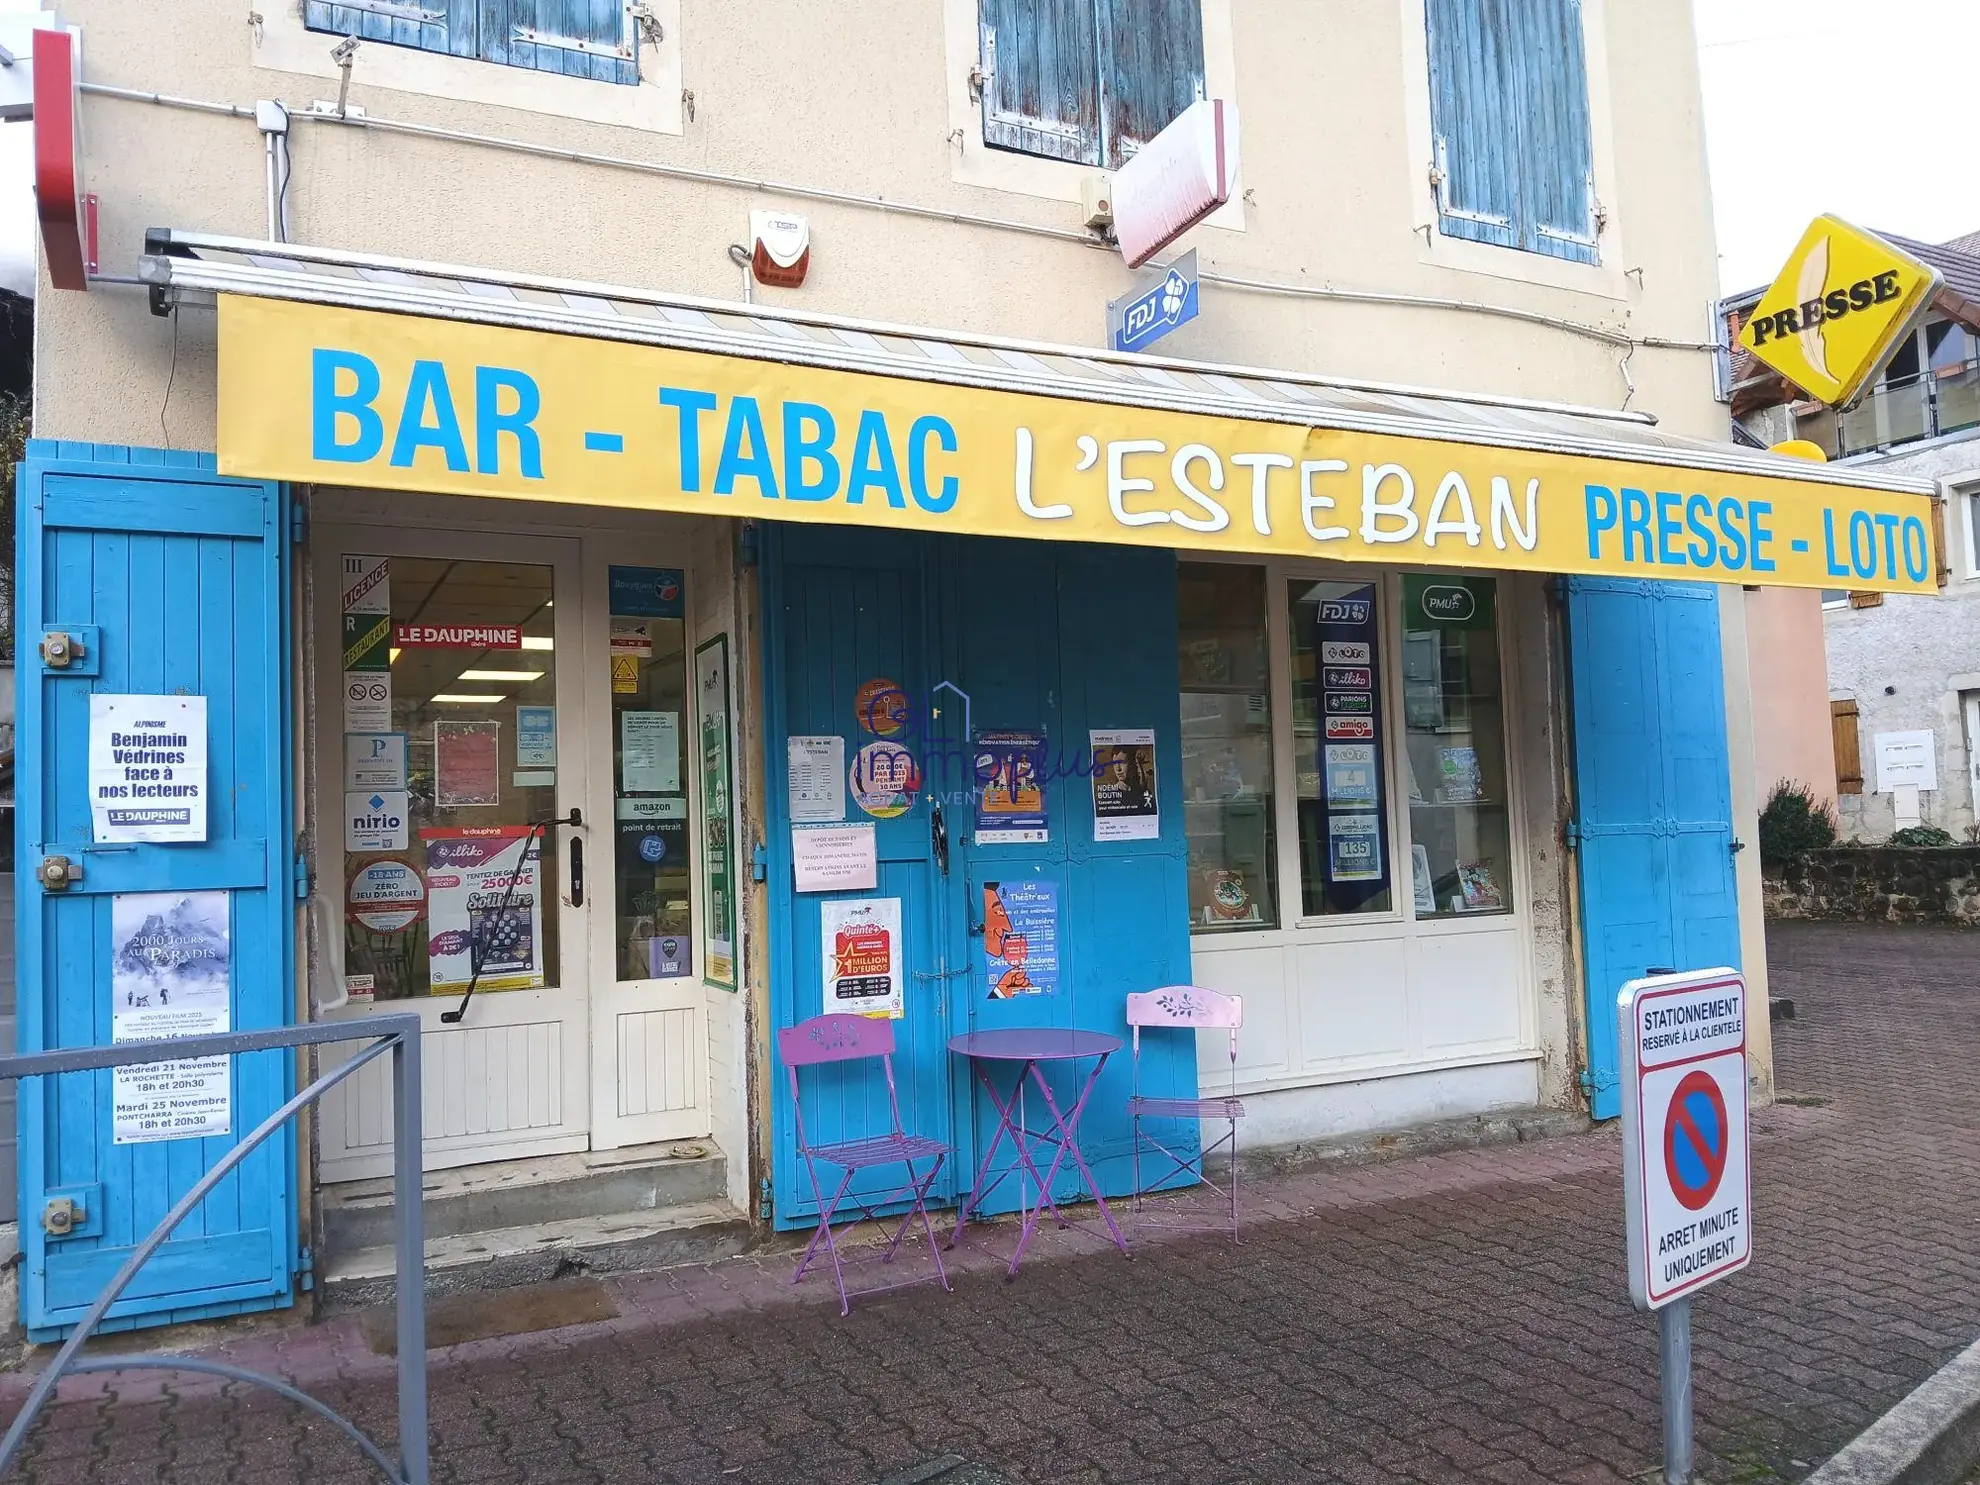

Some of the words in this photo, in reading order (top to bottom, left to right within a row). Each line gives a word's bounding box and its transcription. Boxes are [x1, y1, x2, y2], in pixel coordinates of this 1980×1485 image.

[1752, 269, 1901, 347] PRESSE
[1127, 296, 1157, 336] FDJ
[312, 348, 545, 480] BAR
[585, 431, 624, 453] -
[659, 386, 960, 514] TABAC
[1014, 426, 1541, 551] L'ESTEBAN
[1584, 484, 1777, 572] PRESSE
[1791, 539, 1809, 553] -
[1823, 508, 1929, 583] LOTO
[344, 561, 389, 609] LICENCE
[1429, 597, 1453, 610] PMU
[1321, 604, 1350, 620] FDJ
[346, 616, 356, 631] R
[399, 628, 422, 642] LE
[343, 619, 388, 667] RESTAURANT
[1338, 647, 1365, 659] LOTO
[1338, 671, 1366, 686] illiko
[133, 720, 167, 728] ALPINISME
[1339, 719, 1369, 736] amigo
[111, 732, 187, 748] Benjamin
[113, 749, 185, 764] Védrines
[125, 766, 160, 781] face
[163, 766, 173, 781] à
[99, 785, 129, 798] nos
[132, 783, 198, 798] lecteurs
[1097, 791, 1122, 799] BOUTIN
[633, 803, 671, 811] amazon
[111, 812, 125, 821] LE
[353, 814, 400, 829] nirio
[622, 823, 646, 833] point
[647, 823, 654, 831] de
[657, 823, 681, 831] retrait
[449, 844, 484, 857] illiko
[1345, 842, 1367, 854] 135
[385, 870, 404, 878] ANS
[466, 872, 492, 880] TENTEZ
[504, 868, 533, 876] GANER
[356, 891, 371, 899] JEU
[374, 889, 418, 899] D'ARGENT
[844, 923, 881, 936] Quinté+
[132, 936, 165, 947] 2000
[128, 949, 142, 957] AU
[150, 947, 216, 960] PARADIS
[852, 956, 888, 965] MILLION
[844, 960, 852, 974] 1
[853, 963, 888, 973] D'EUROS
[1644, 997, 1740, 1032] STATIONNEMENT
[1681, 1026, 1689, 1045] À
[1689, 1027, 1701, 1043] LA
[1701, 1018, 1742, 1039] CLIENTELE
[116, 1065, 160, 1075] Vendredi
[163, 1063, 176, 1071] 21
[179, 1061, 227, 1070] Novembre
[133, 1073, 175, 1082] ROCHETTE
[136, 1083, 156, 1092] 18h
[159, 1081, 170, 1090] et
[172, 1079, 205, 1089] 20h30
[116, 1103, 149, 1112] Mardi
[152, 1101, 166, 1110] 25
[170, 1097, 227, 1108] Novembre
[117, 1111, 173, 1121] PONTCHARRA
[138, 1120, 158, 1130] 18h
[161, 1118, 171, 1127] et
[174, 1116, 207, 1126] 20h30
[1658, 1223, 1697, 1257] ARRET
[1699, 1206, 1740, 1238] MINUTE
[1663, 1234, 1737, 1284] UNIQUEMENT
